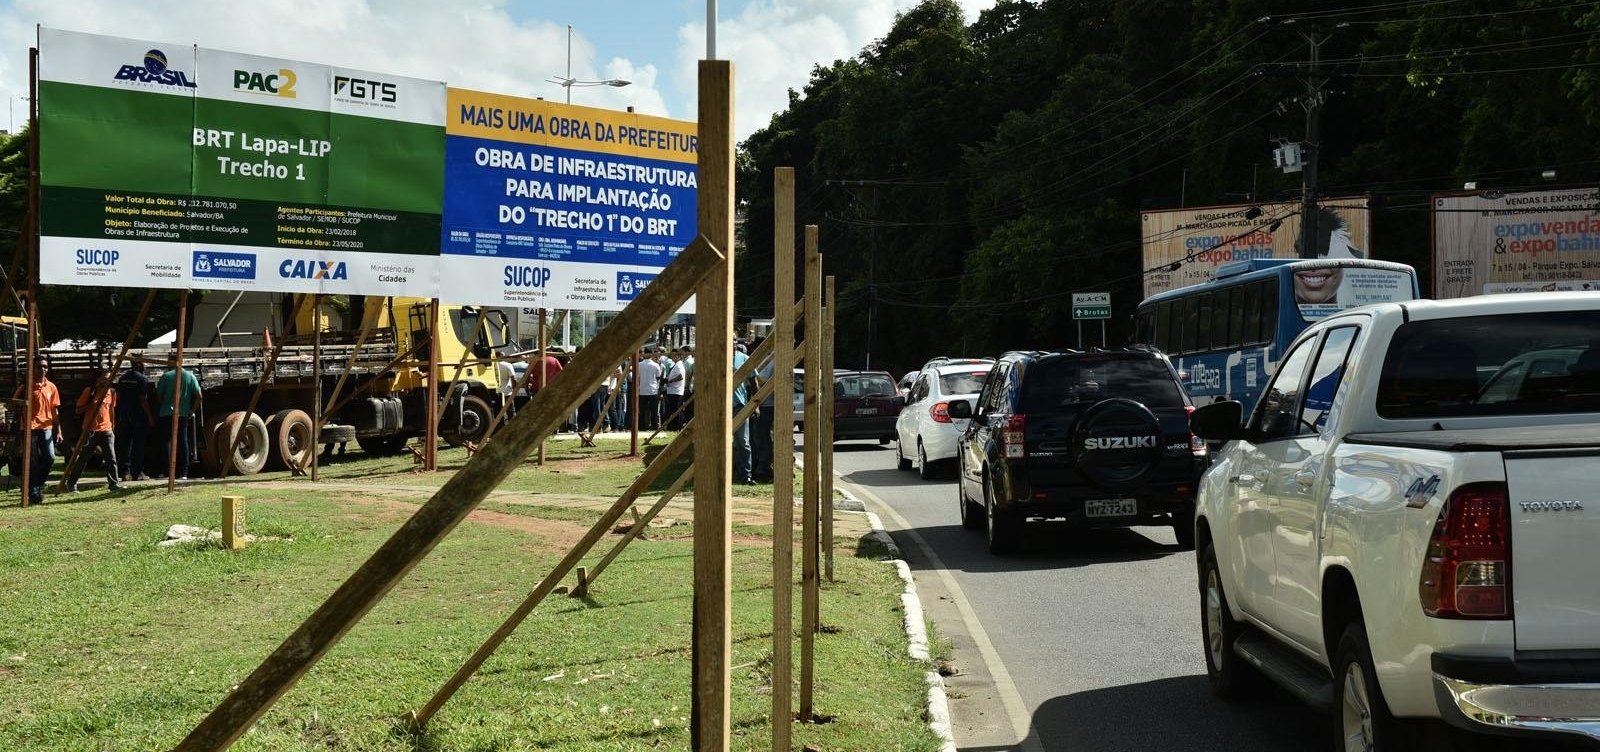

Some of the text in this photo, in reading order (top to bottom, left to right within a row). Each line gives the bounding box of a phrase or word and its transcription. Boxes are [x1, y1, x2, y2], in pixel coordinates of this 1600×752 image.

[114, 65, 197, 87] BRASIL
[234, 68, 297, 98] PAC2
[461, 104, 699, 153] MAIS UMA OBRA DA PREFEITUR
[193, 128, 331, 157] BRT Lapa-LIP
[217, 156, 306, 180] Trecho 1
[475, 147, 698, 188] OBRA DE INFRAESTRUTURA
[177, 199, 187, 207] R$
[506, 178, 671, 211] PARA IMPLANTAÇÃO
[1505, 196, 1541, 205] VENDAS
[142, 208, 185, 217] Beneficiado:
[187, 211, 224, 219] Salvador/BA
[277, 206, 304, 214] Agentes
[134, 221, 168, 230] Elaboração
[499, 205, 525, 224] DO
[620, 217, 644, 234] DO
[647, 219, 677, 237] BRT
[1494, 215, 1600, 240] expovenda
[136, 230, 180, 238] Infraestrutura
[1185, 231, 1273, 250] expovendas
[1509, 233, 1600, 257] expobahi
[76, 248, 119, 265] SUCOP
[213, 258, 251, 268] SALVADOR
[1198, 245, 1274, 266] expobahia
[1581, 259, 1600, 268] Salva
[279, 259, 347, 281] CAIXA
[371, 264, 402, 273] Ministério
[504, 265, 551, 288] SUCOP
[378, 274, 407, 283] Cidades
[574, 277, 600, 285] Secretaria
[1084, 435, 1156, 450] SUZUKI
[1520, 500, 1585, 512] TOYOTA
